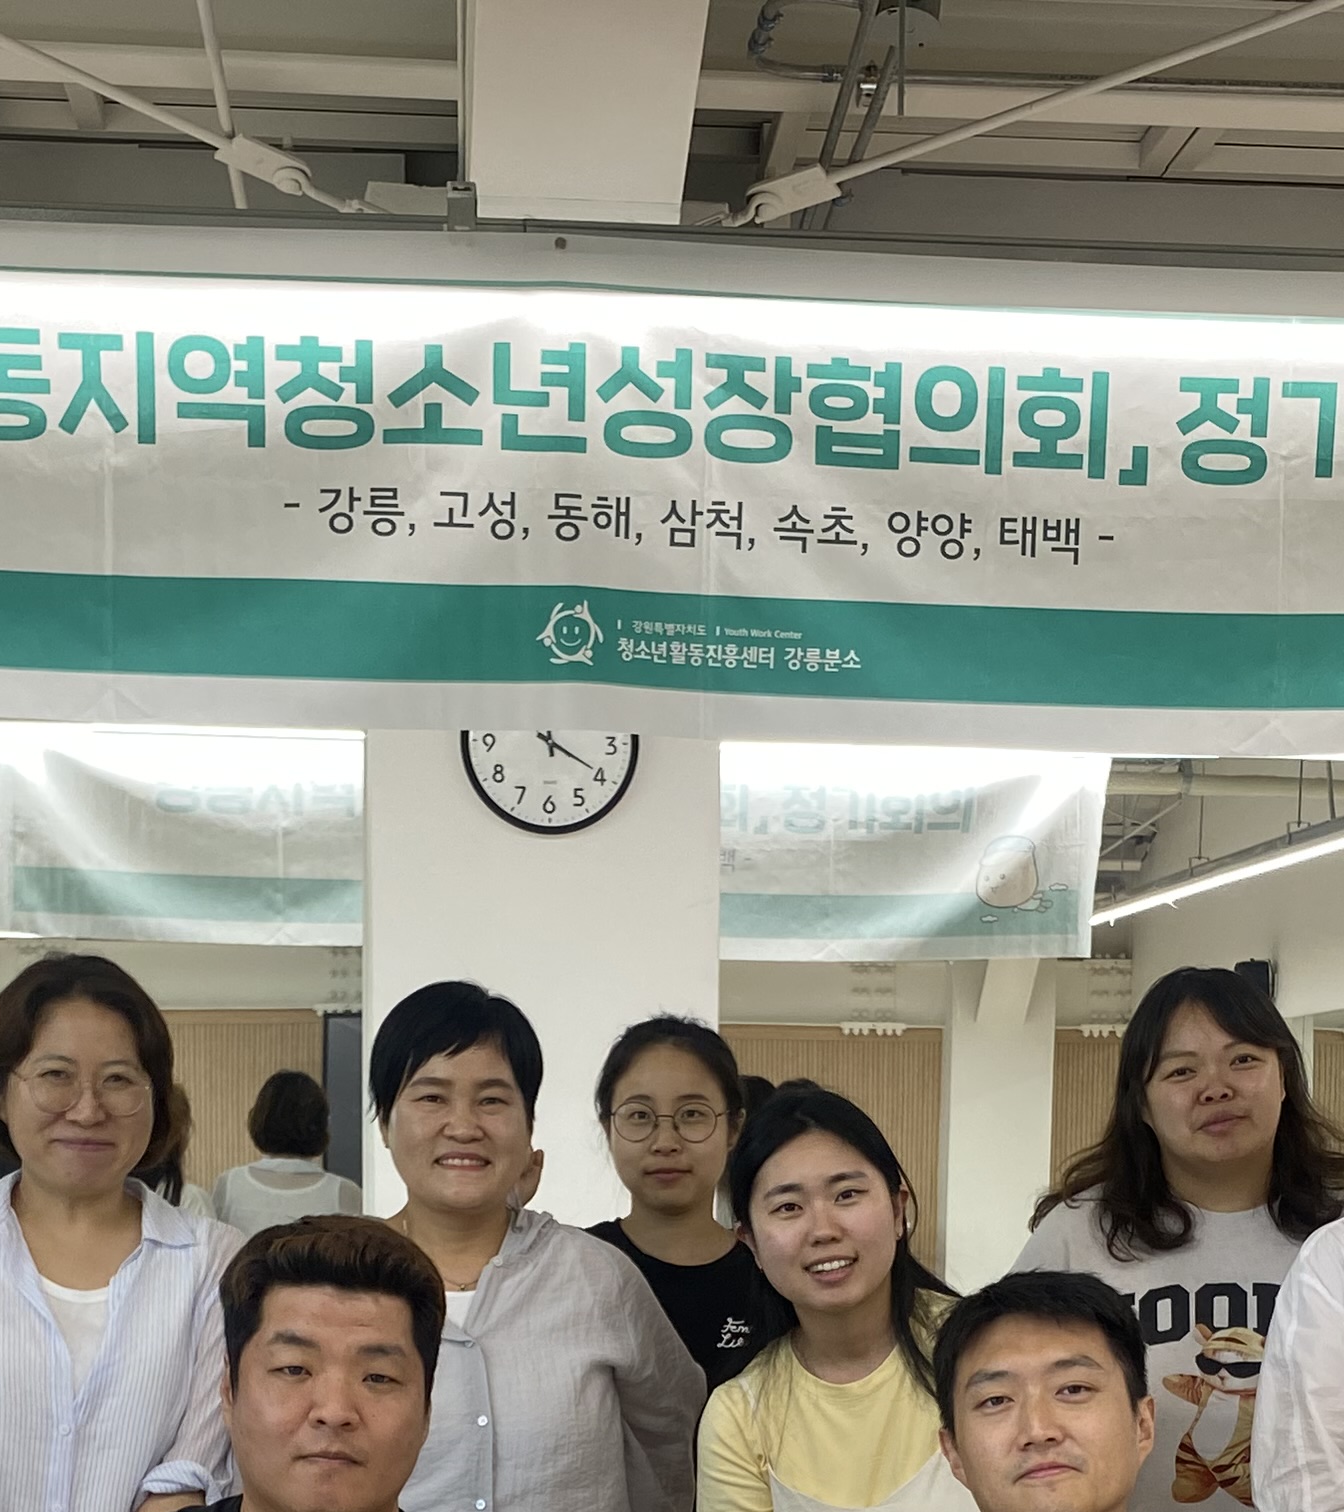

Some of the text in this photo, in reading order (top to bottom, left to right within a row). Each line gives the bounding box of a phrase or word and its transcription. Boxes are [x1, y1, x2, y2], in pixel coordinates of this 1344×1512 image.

[317, 486, 416, 537] 강릉,
[432, 490, 530, 541] 고성,
[547, 492, 643, 546] 동해,
[659, 498, 756, 552] 삼척,
[772, 503, 869, 557] 속초,
[886, 510, 981, 561] 양양,
[998, 515, 1081, 566] 태백
[631, 620, 708, 637] 강원특별자치도
[723, 627, 804, 641] Youth Work Center
[617, 637, 862, 673] 청소년활동진흥센터 강릉분소
[482, 733, 496, 752] 9
[605, 736, 617, 755] 3
[492, 763, 505, 783] 8
[592, 767, 607, 786] 4
[514, 785, 526, 805] 7
[542, 795, 556, 814] 6
[572, 787, 586, 807] 5
[1122, 1282, 1282, 1346] OO
